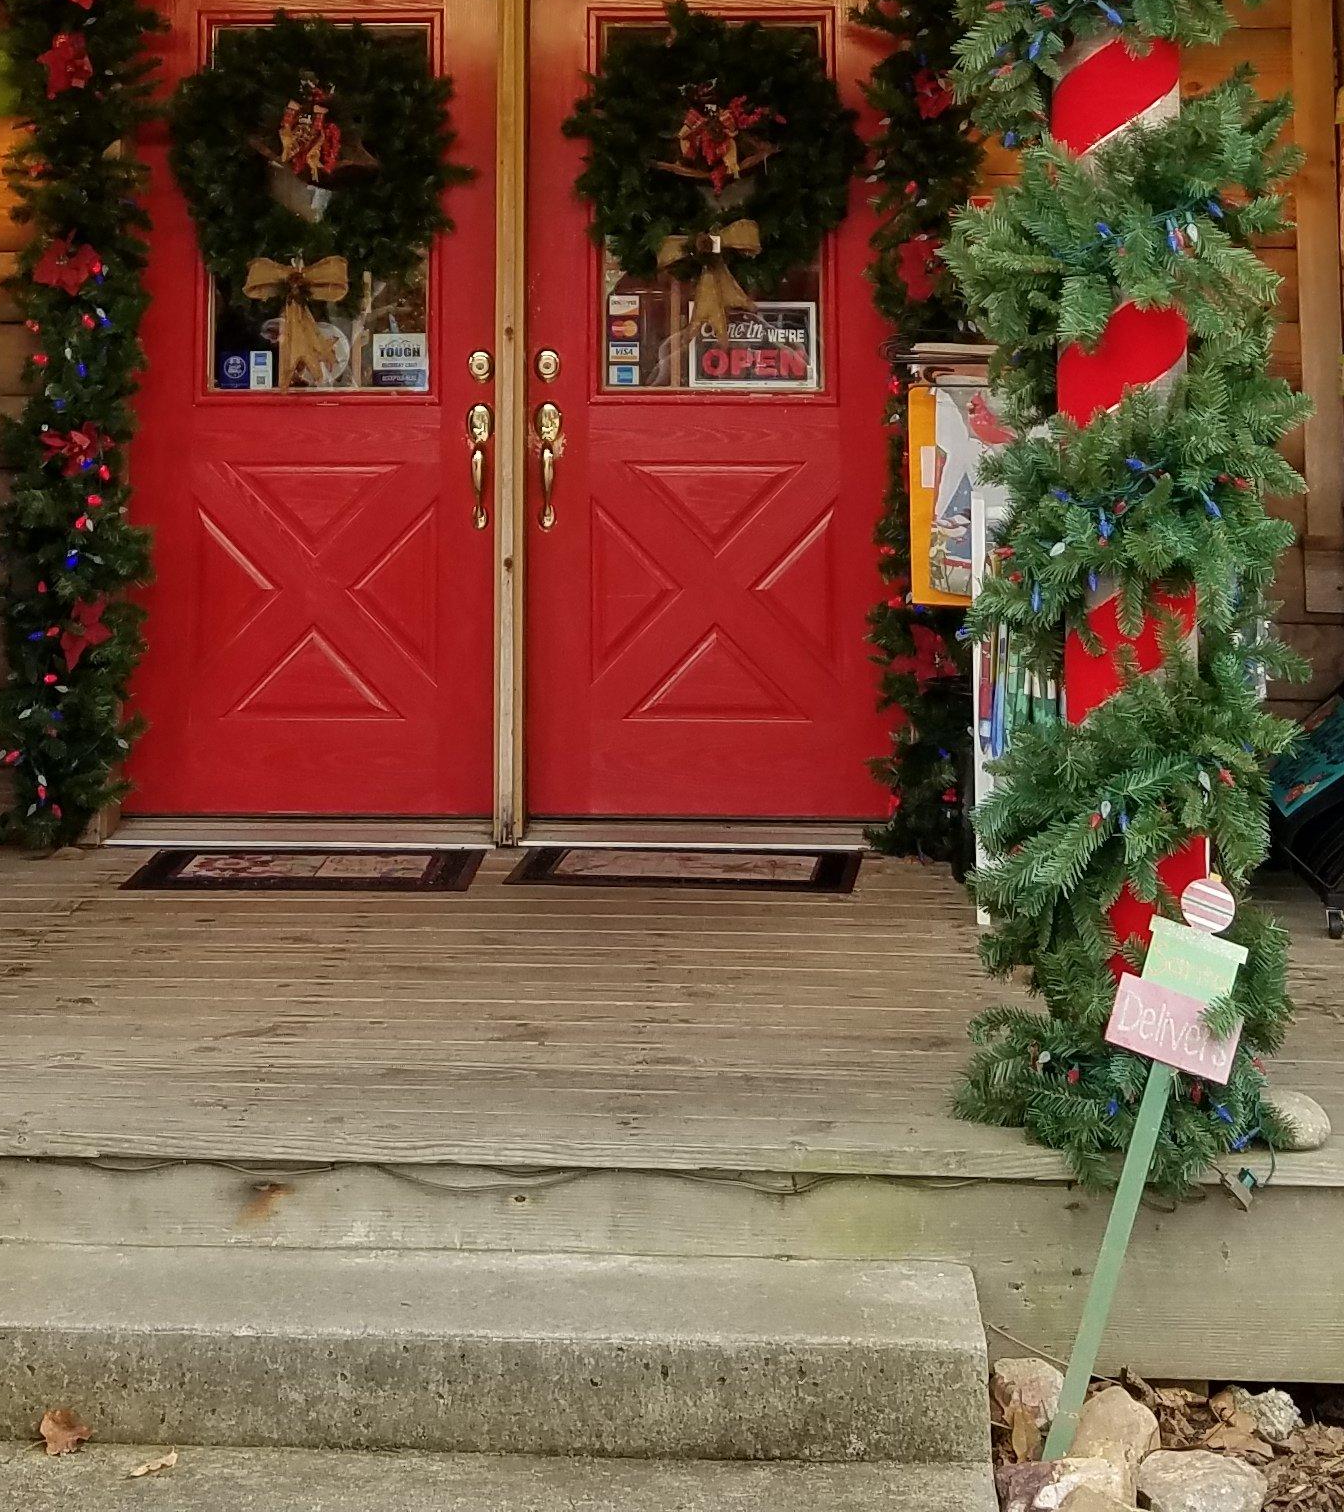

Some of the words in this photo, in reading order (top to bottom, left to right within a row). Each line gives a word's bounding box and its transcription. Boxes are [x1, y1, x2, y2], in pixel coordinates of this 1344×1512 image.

[767, 329, 805, 343] WE'RE
[379, 347, 421, 358] TOUGH
[616, 347, 634, 356] VISA
[701, 348, 808, 378] OPEN
